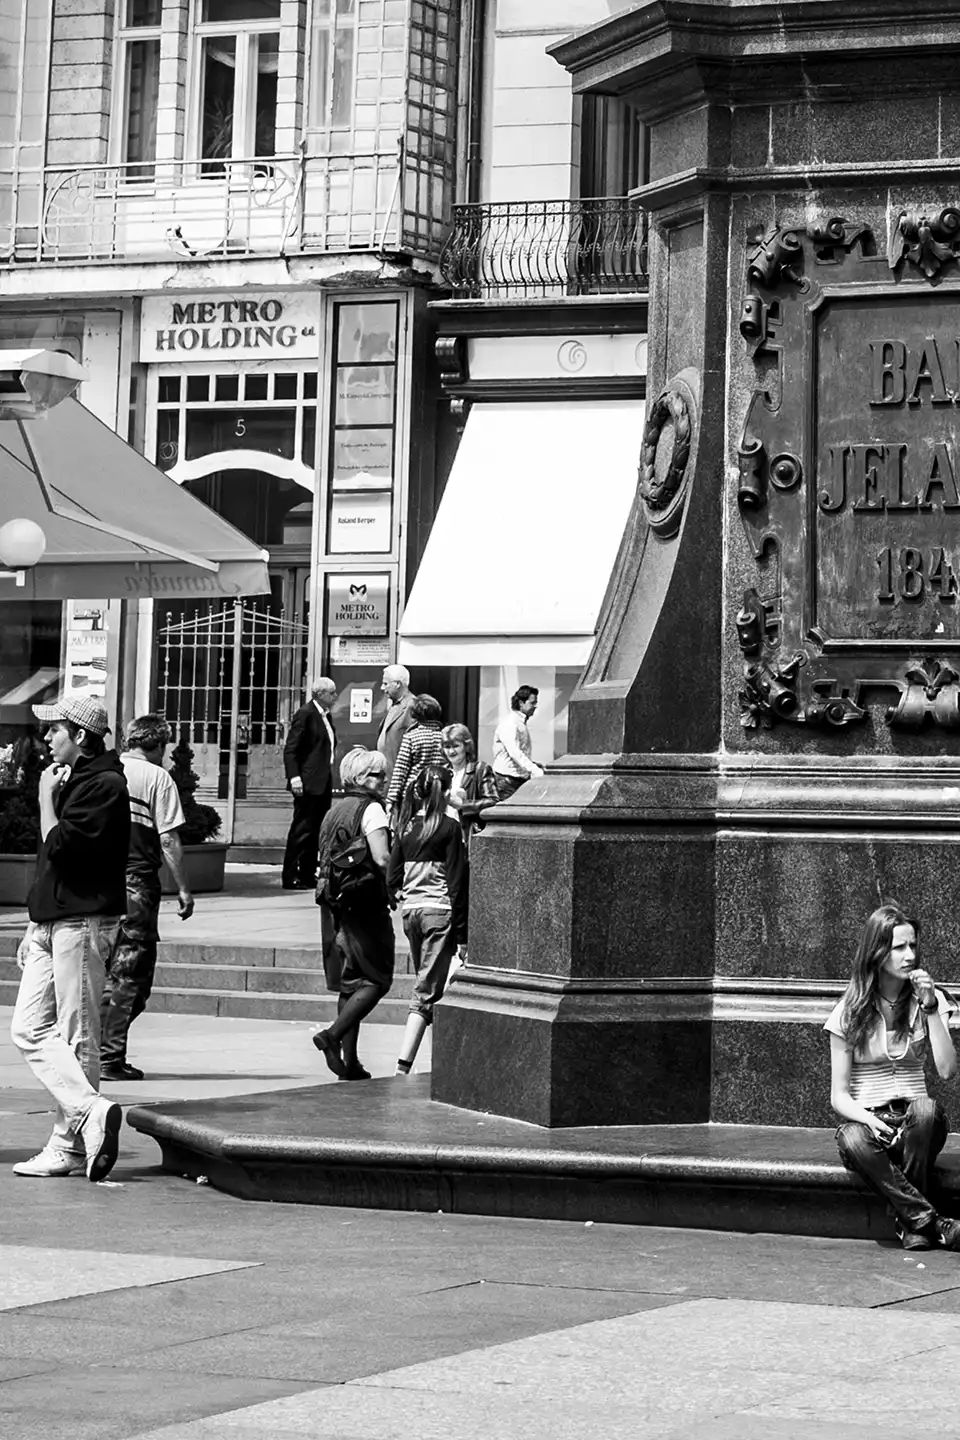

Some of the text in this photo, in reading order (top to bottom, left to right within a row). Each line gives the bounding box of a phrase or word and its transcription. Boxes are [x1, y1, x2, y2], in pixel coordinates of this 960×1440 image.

[172, 299, 283, 325] METRO
[155, 325, 298, 351] HOLDING
[234, 418, 246, 437] 5
[335, 612, 380, 621] HOLDING
[340, 603, 375, 612] METRO
